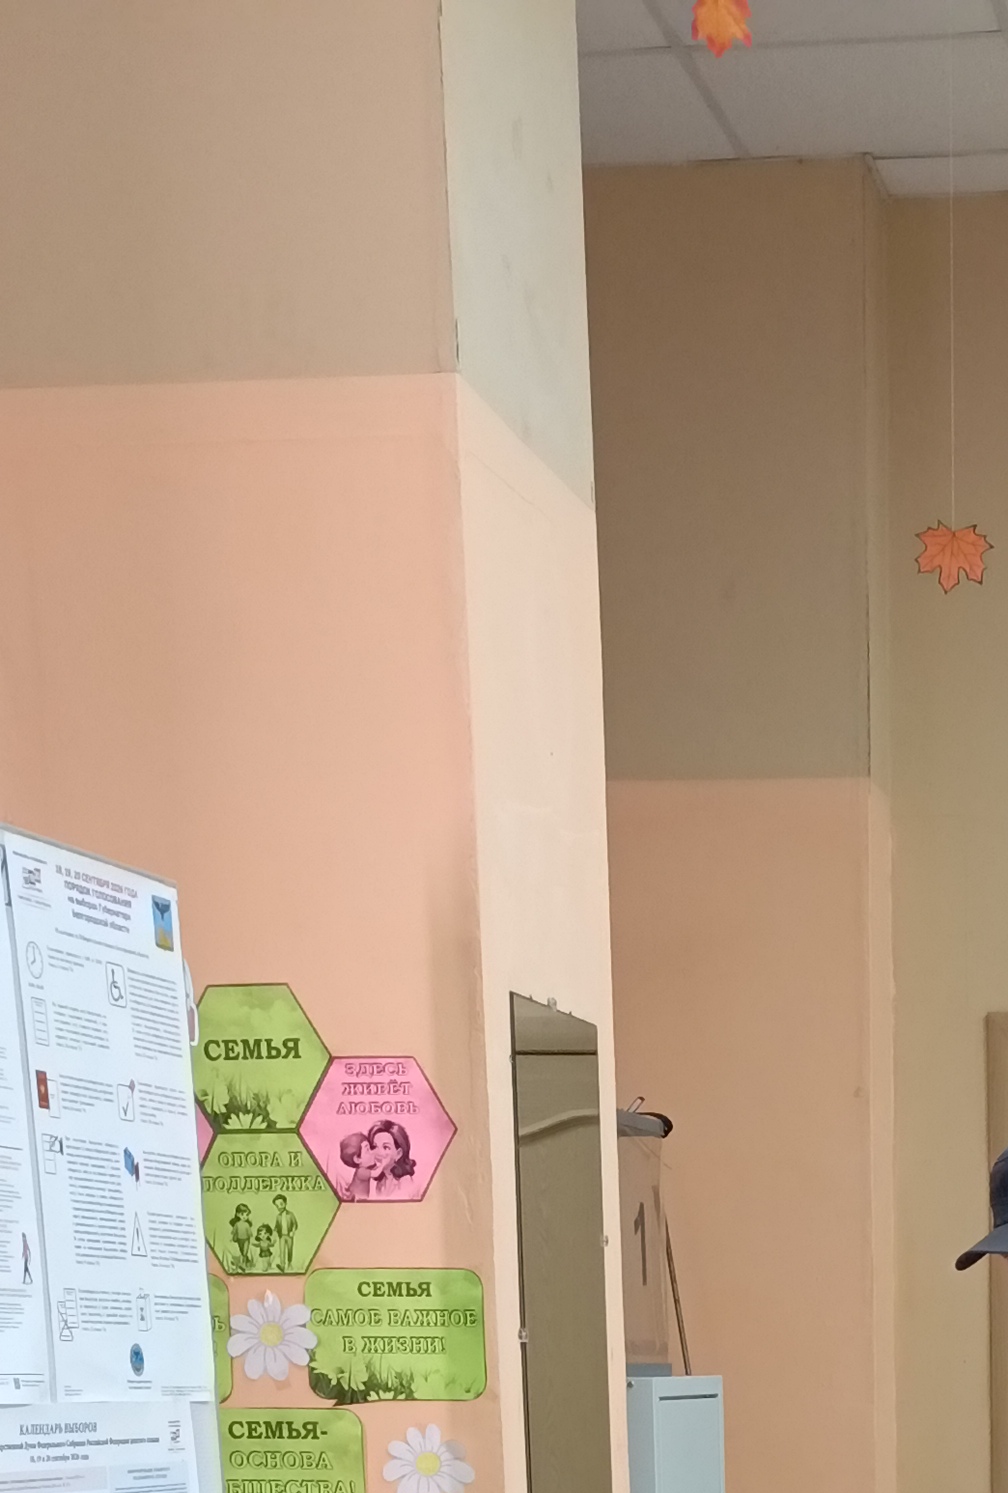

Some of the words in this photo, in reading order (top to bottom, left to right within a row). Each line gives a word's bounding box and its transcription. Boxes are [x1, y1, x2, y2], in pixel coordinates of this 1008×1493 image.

[203, 1037, 302, 1061] СЕМЬЯ
[344, 1062, 409, 1078] ЗДЕСЬ
[341, 1079, 413, 1096] ЖИВЁТ
[336, 1101, 420, 1115] ЛЮБОВЬ
[217, 1151, 284, 1168] ОПОРА
[287, 1151, 304, 1168] И
[201, 1175, 328, 1195] ПОДДЕРЖКА
[356, 1281, 433, 1298] СЕМЬЯ
[310, 1307, 383, 1328] САМОЕ
[386, 1307, 479, 1328] ВАЖНОЕ
[342, 1335, 357, 1354] В
[361, 1335, 447, 1355] ЖИЗНИ!
[228, 1420, 329, 1440] СЕМЬЯ-
[229, 1450, 333, 1471] ОСНОВА
